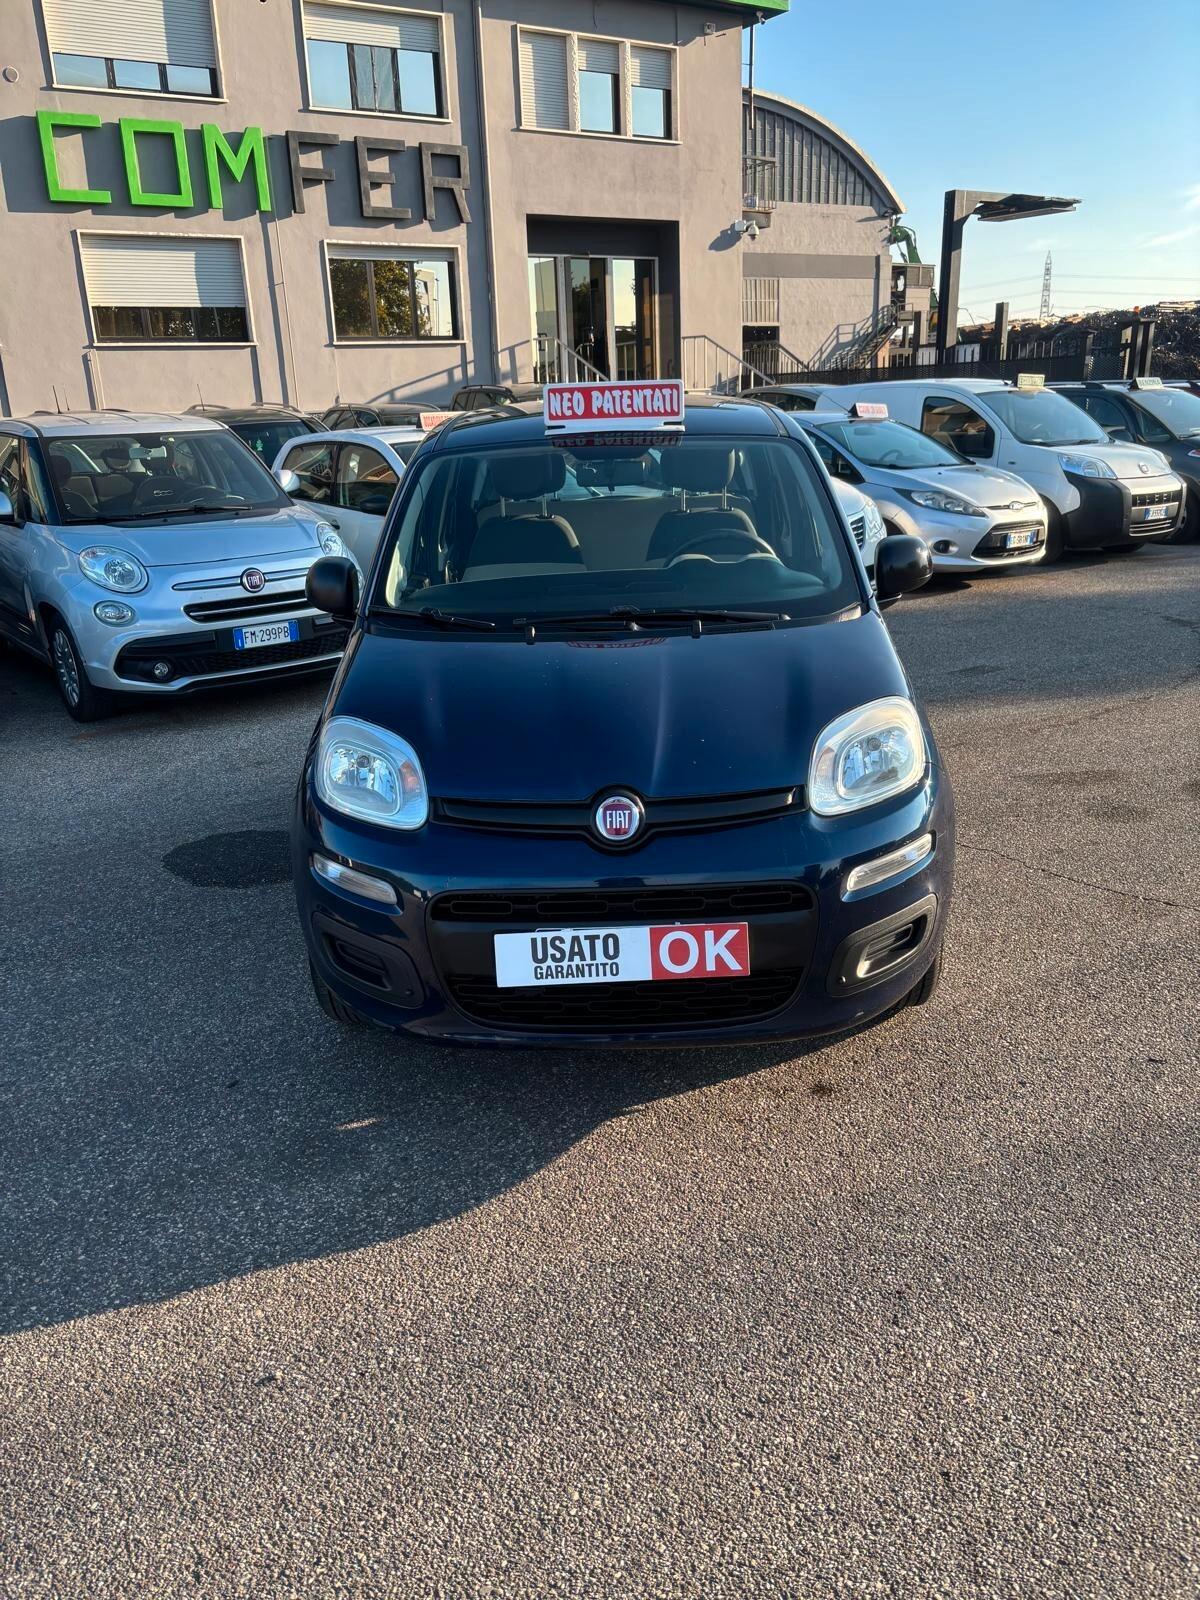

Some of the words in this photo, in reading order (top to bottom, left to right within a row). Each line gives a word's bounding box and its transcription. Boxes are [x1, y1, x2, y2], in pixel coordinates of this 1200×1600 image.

[36, 110, 473, 223] COMFER
[550, 391, 585, 417] NEO
[591, 388, 679, 416] PATENTATI
[247, 575, 260, 586] FIAT
[606, 810, 631, 829] FIAT
[531, 933, 620, 964] USATO
[659, 929, 743, 974] OK
[534, 962, 620, 980] GARANTITO
